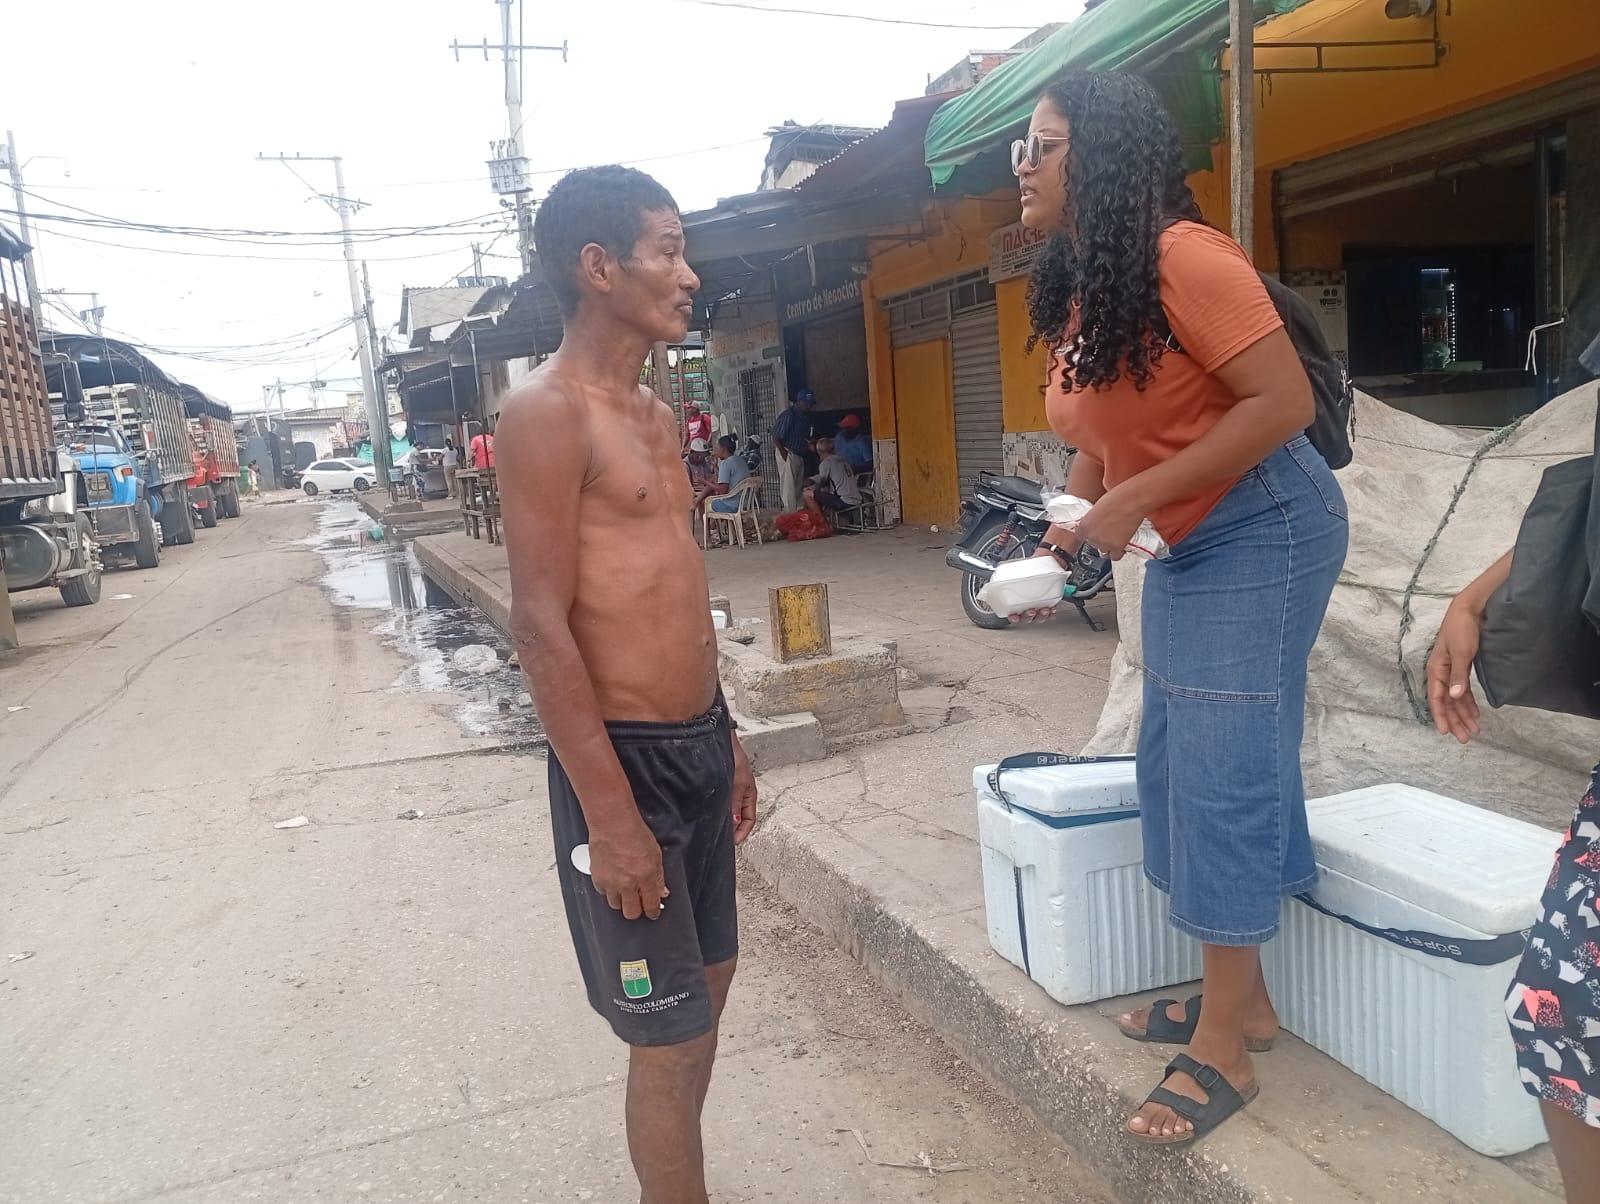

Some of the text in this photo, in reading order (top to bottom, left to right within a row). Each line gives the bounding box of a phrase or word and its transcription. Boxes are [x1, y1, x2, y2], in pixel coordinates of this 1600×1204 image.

[786, 280, 860, 319] Centro de Negocios
[643, 991, 690, 1009] COLOMBIANO
